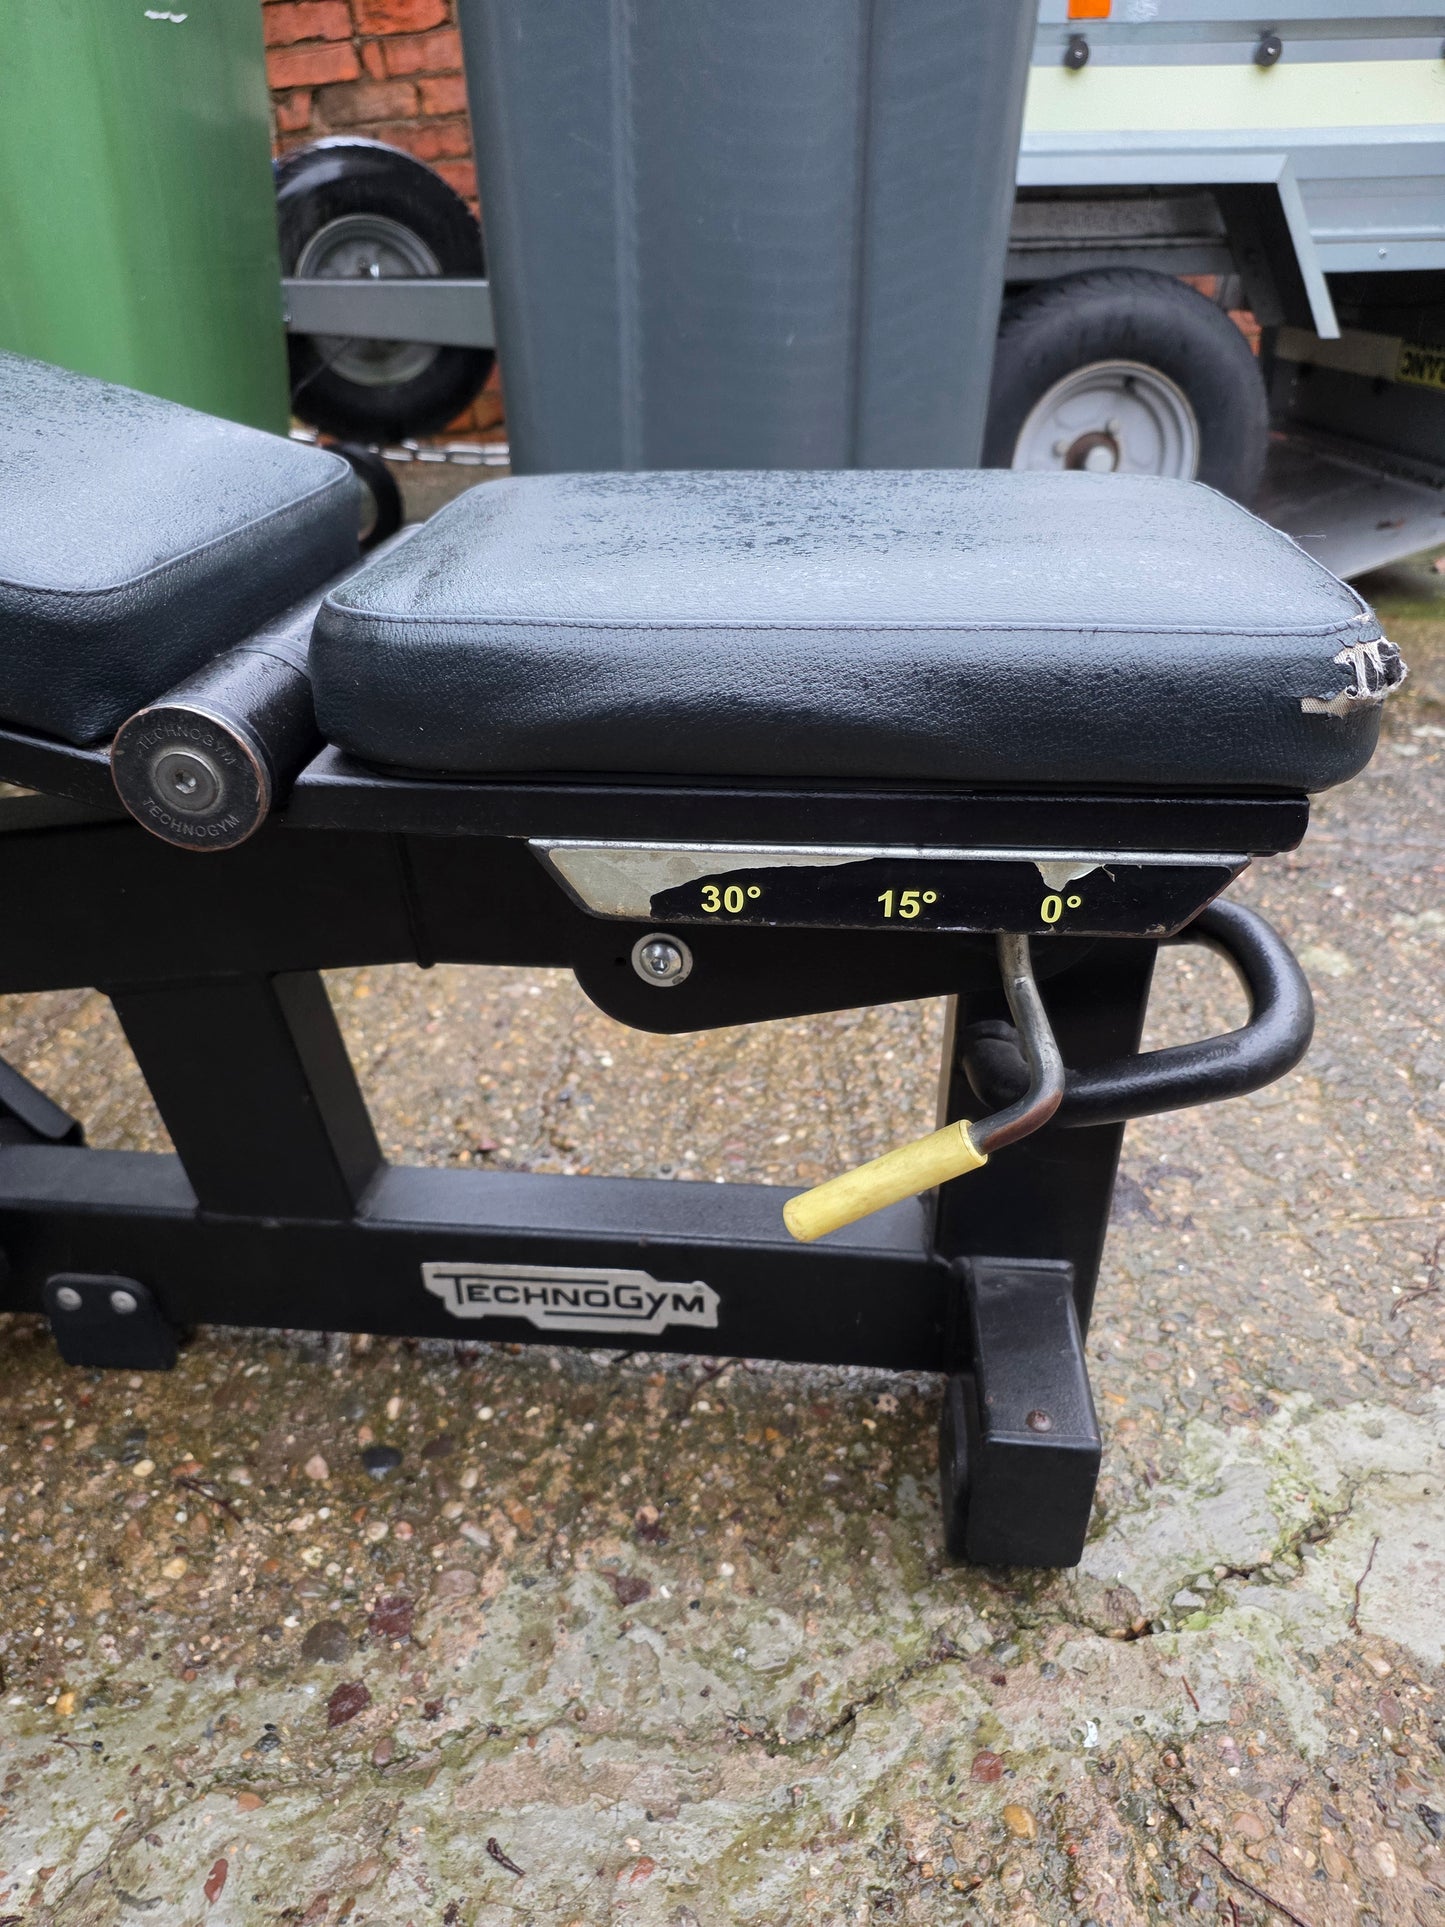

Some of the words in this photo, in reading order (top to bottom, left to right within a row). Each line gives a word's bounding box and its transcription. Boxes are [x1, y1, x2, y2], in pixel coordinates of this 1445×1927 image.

[143, 796, 241, 838] TECHNOGYM
[700, 885, 762, 914] 30°
[876, 890, 938, 919] 15°
[1039, 895, 1083, 924] 0°
